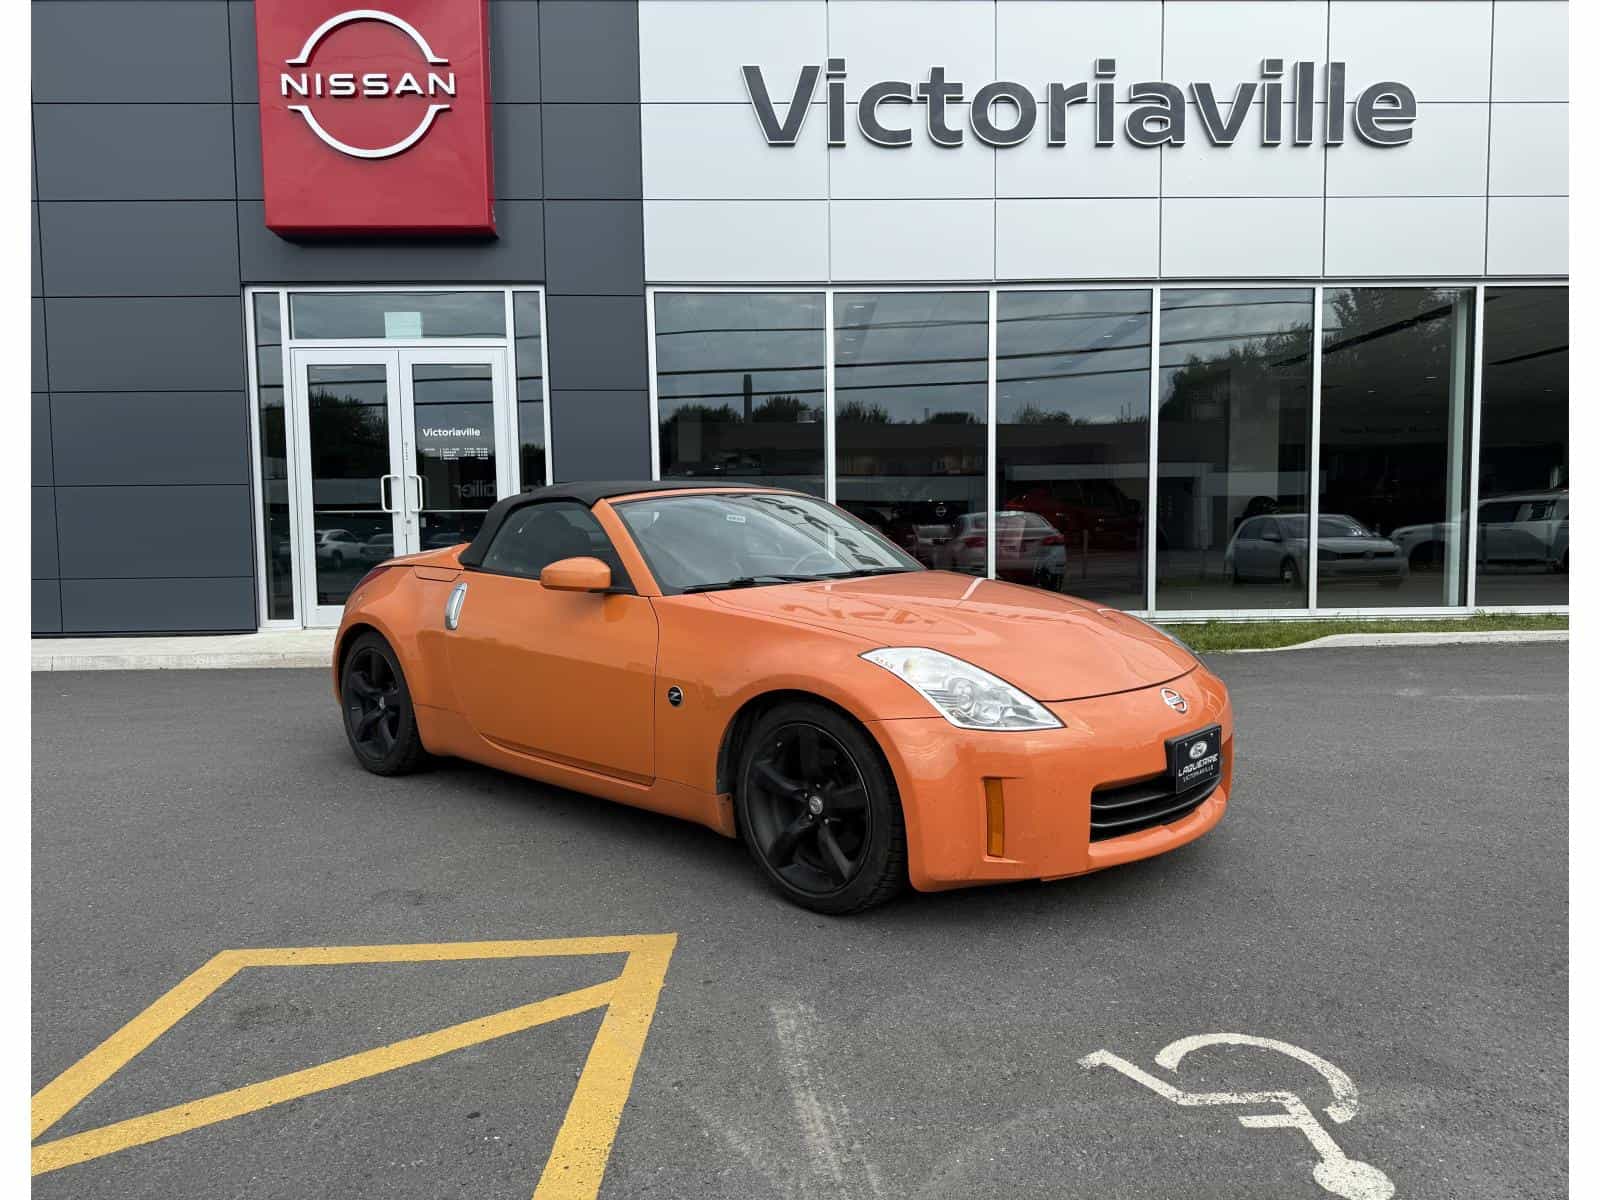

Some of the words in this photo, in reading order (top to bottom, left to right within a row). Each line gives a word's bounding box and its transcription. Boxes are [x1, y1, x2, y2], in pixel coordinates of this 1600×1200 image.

[280, 72, 456, 96] NISSAN
[740, 58, 1418, 148] Victoriaville
[422, 427, 481, 437] Victoriaville
